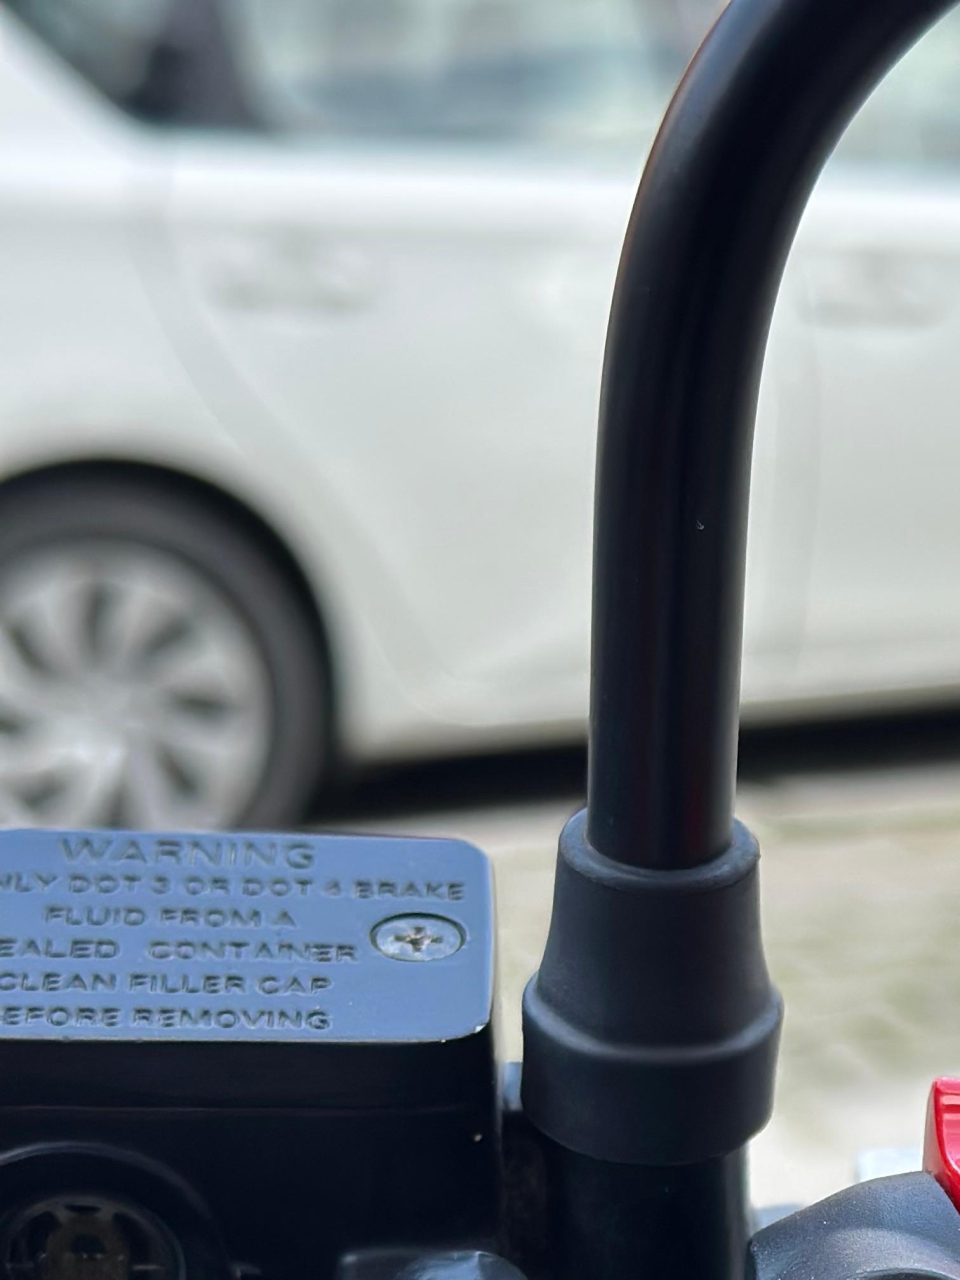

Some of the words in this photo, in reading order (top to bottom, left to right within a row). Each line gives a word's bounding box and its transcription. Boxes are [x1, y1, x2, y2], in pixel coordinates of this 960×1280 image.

[61, 837, 315, 869] WARNING
[69, 873, 141, 894] DOT
[185, 876, 230, 896] OR
[242, 877, 313, 897] DOT
[353, 880, 465, 900] BRAKE
[45, 904, 145, 926] FLUID
[160, 907, 262, 927] FROM
[273, 910, 297, 927] A
[150, 940, 358, 962] CONTAINER
[0, 970, 117, 992] CLEAN
[129, 973, 246, 994] FILLER
[258, 975, 332, 995] CAP
[134, 1007, 331, 1031] REMOVING
